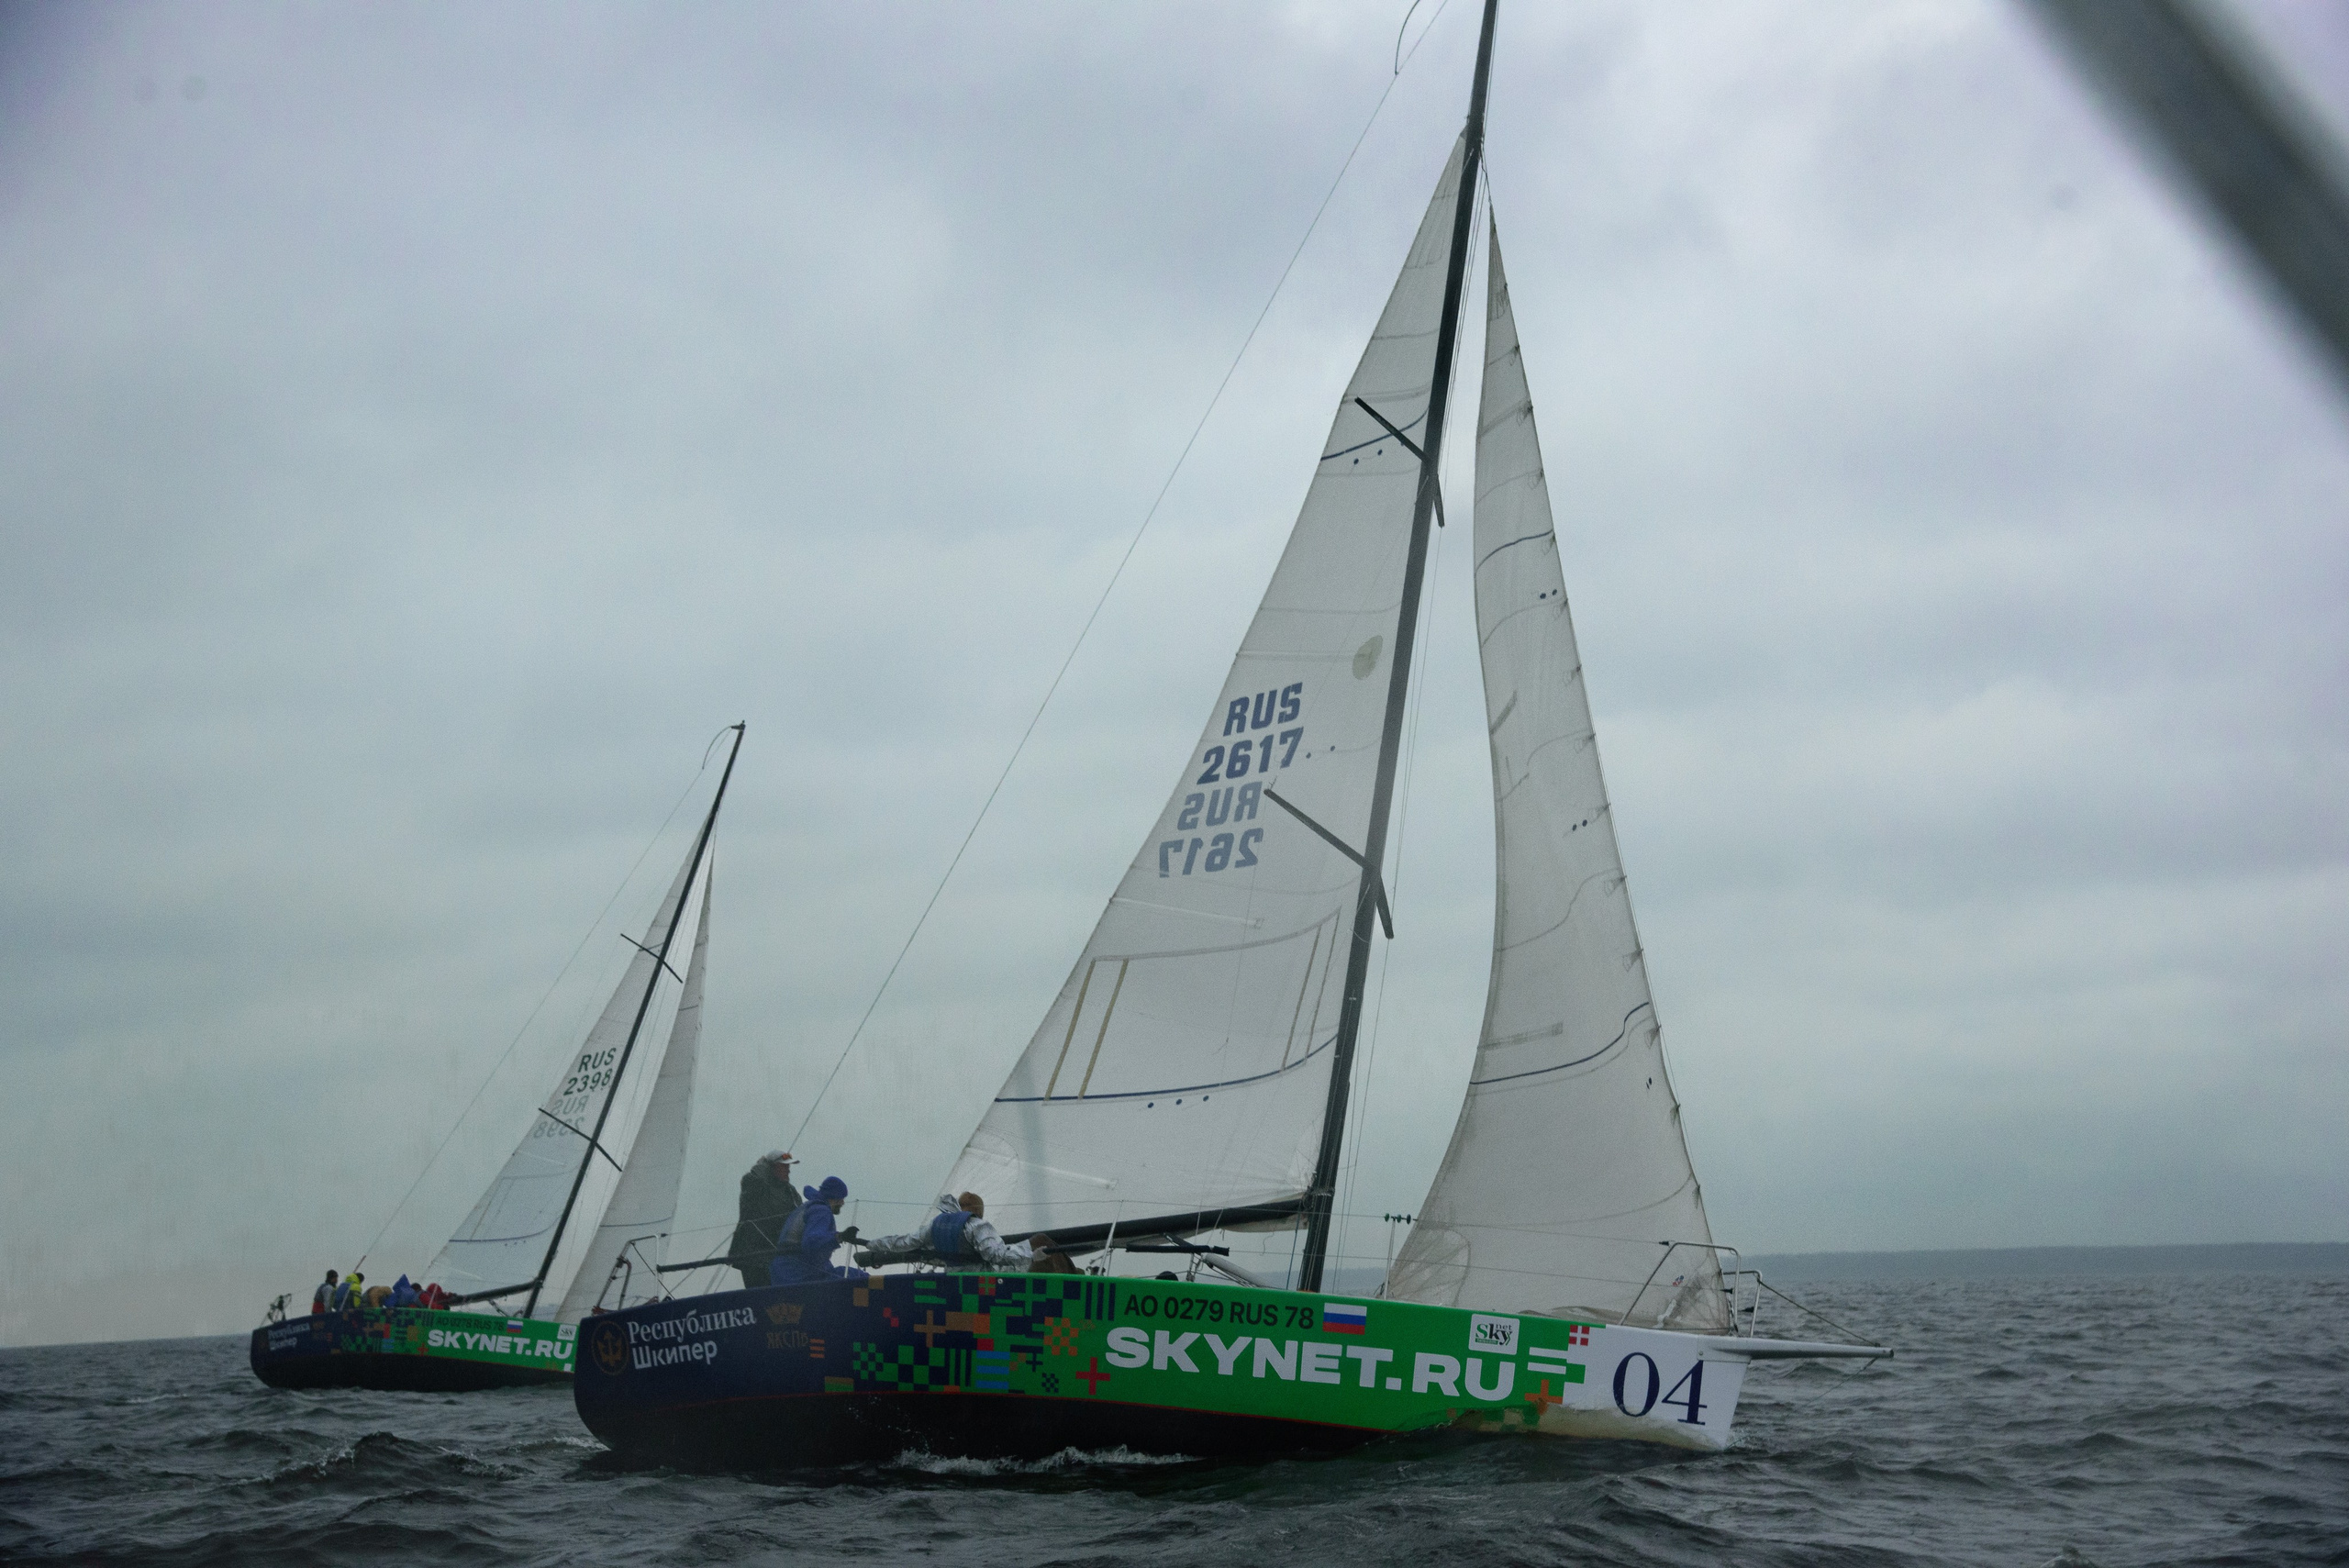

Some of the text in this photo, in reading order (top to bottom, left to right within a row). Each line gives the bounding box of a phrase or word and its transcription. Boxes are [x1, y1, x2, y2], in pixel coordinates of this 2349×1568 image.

[1223, 682, 1303, 737] RUS
[1197, 727, 1304, 785] 2617
[577, 1047, 617, 1073] RUS
[563, 1068, 613, 1095] 2398
[627, 1307, 757, 1344] Республика
[1163, 1296, 1224, 1323] 0279
[1230, 1301, 1278, 1328] RUS
[1285, 1306, 1314, 1329] 78
[427, 1329, 573, 1360] SKYNET.RU
[632, 1340, 718, 1371] Шкипер
[1106, 1327, 1516, 1402] SKYNET.RU
[1612, 1351, 1708, 1426] 04
